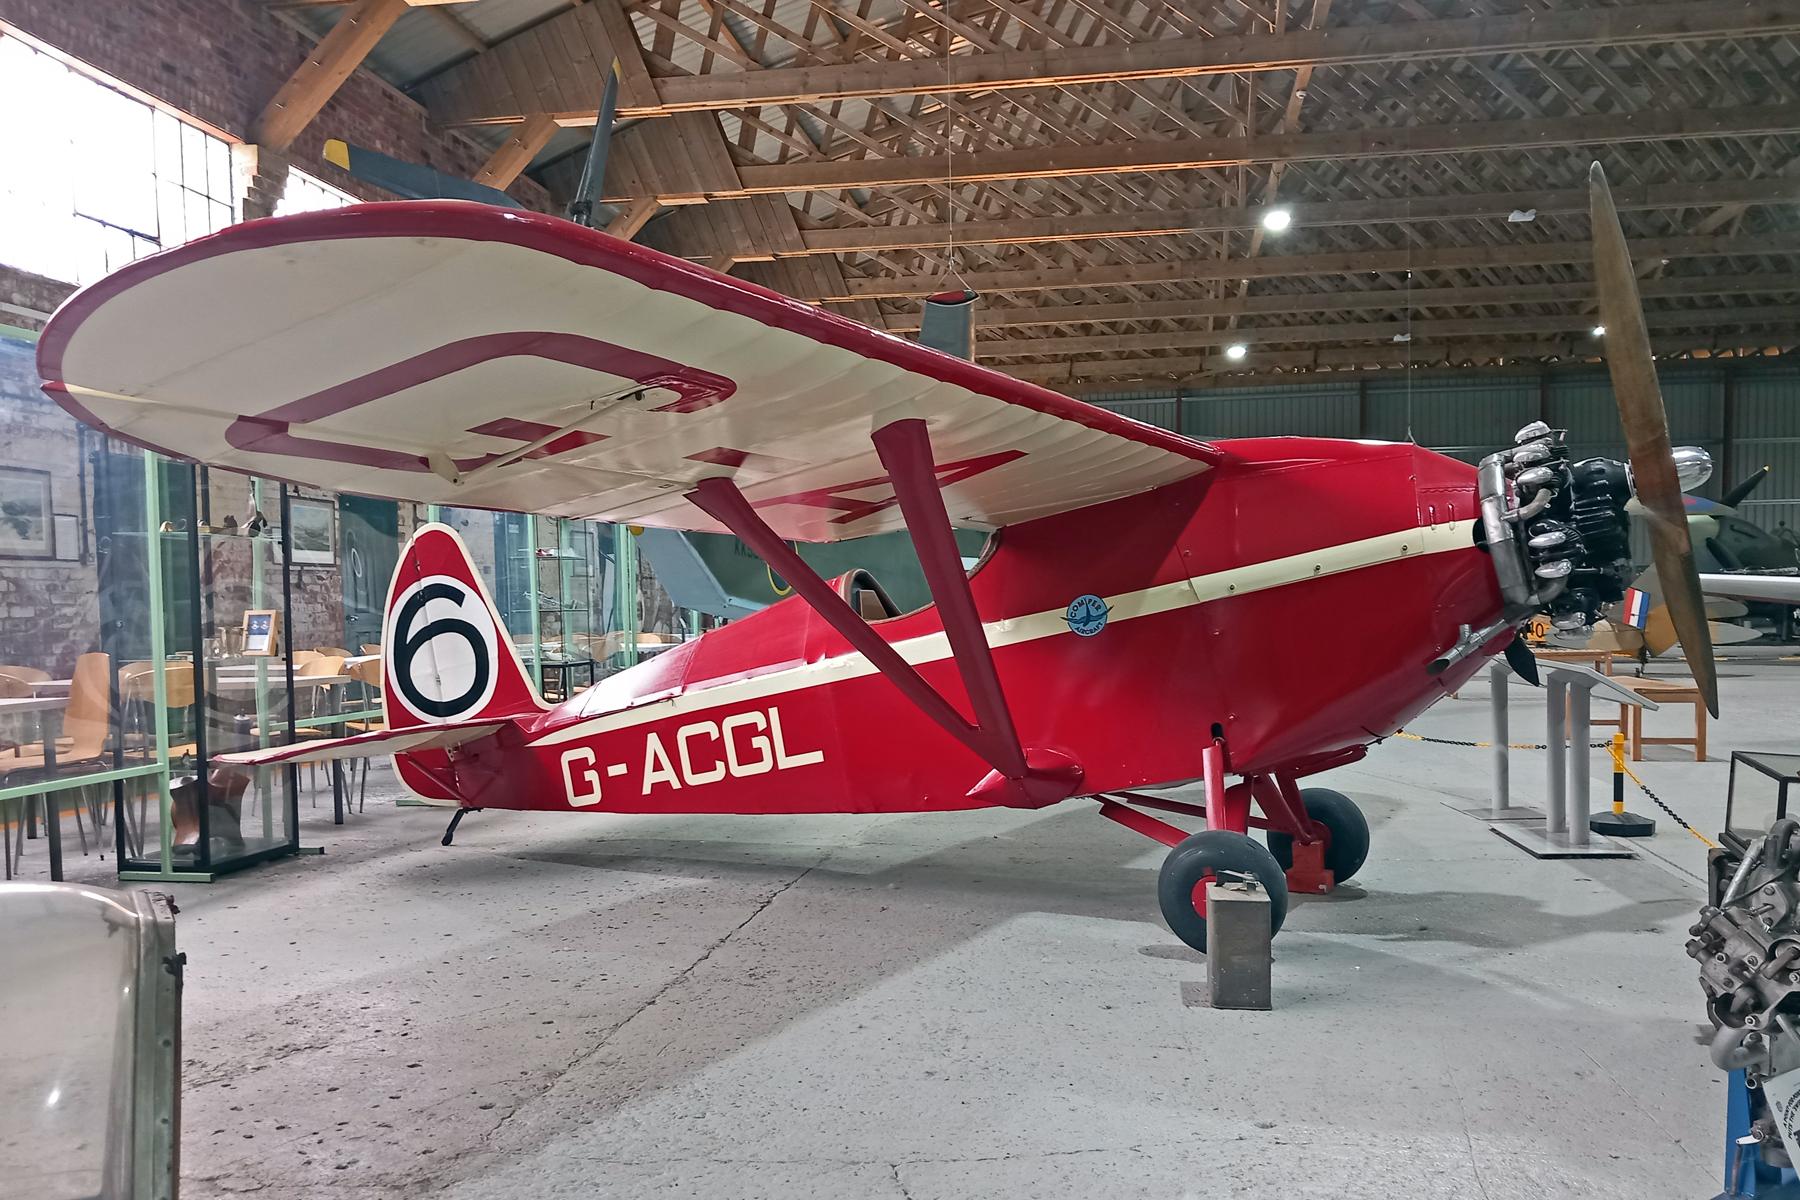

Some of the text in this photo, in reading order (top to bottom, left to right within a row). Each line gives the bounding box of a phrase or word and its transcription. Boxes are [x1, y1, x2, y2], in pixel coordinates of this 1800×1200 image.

[1070, 598, 1102, 618] COMPER
[1075, 621, 1103, 635] AIRCRAFT
[393, 582, 489, 718] 6
[560, 706, 824, 808] G-ACGL
